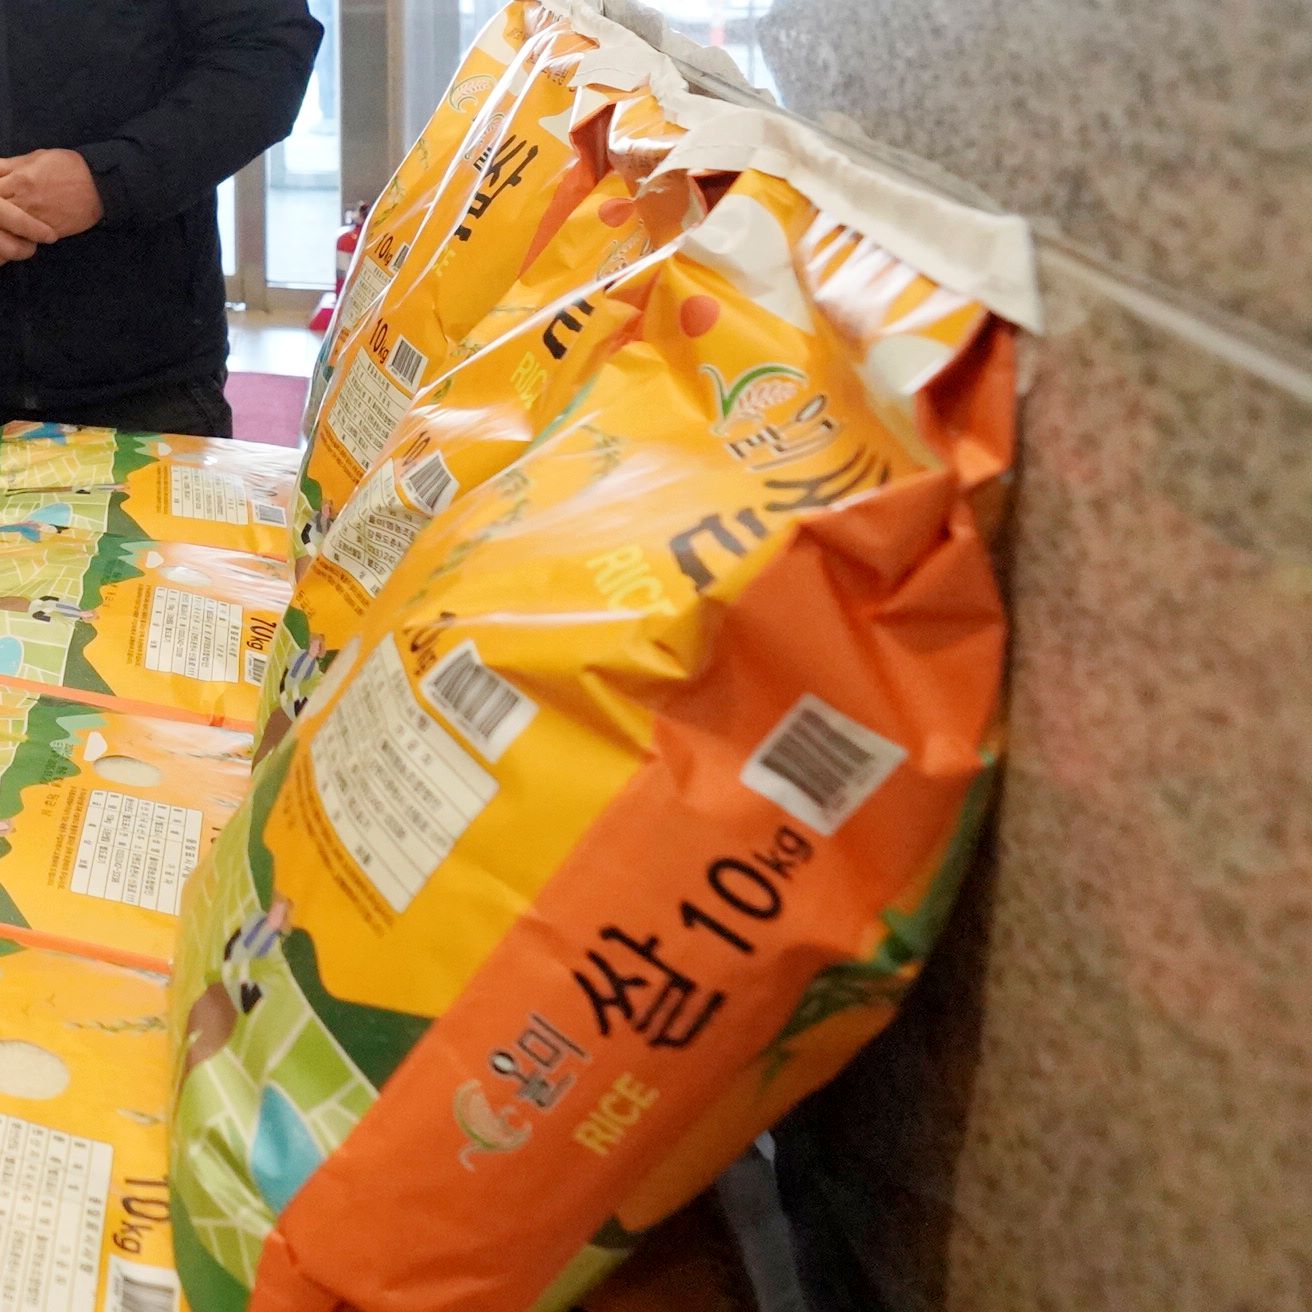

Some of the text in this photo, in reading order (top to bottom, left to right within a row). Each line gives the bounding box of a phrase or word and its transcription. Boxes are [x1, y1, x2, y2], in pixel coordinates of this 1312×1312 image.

[374, 232, 394, 266] 10kg
[369, 318, 391, 364] 10kg
[246, 617, 277, 651] 10kg
[489, 823, 815, 1110] 올미 쌀 10kg
[573, 1070, 662, 1159] RICE
[113, 1175, 172, 1255] 10kg
